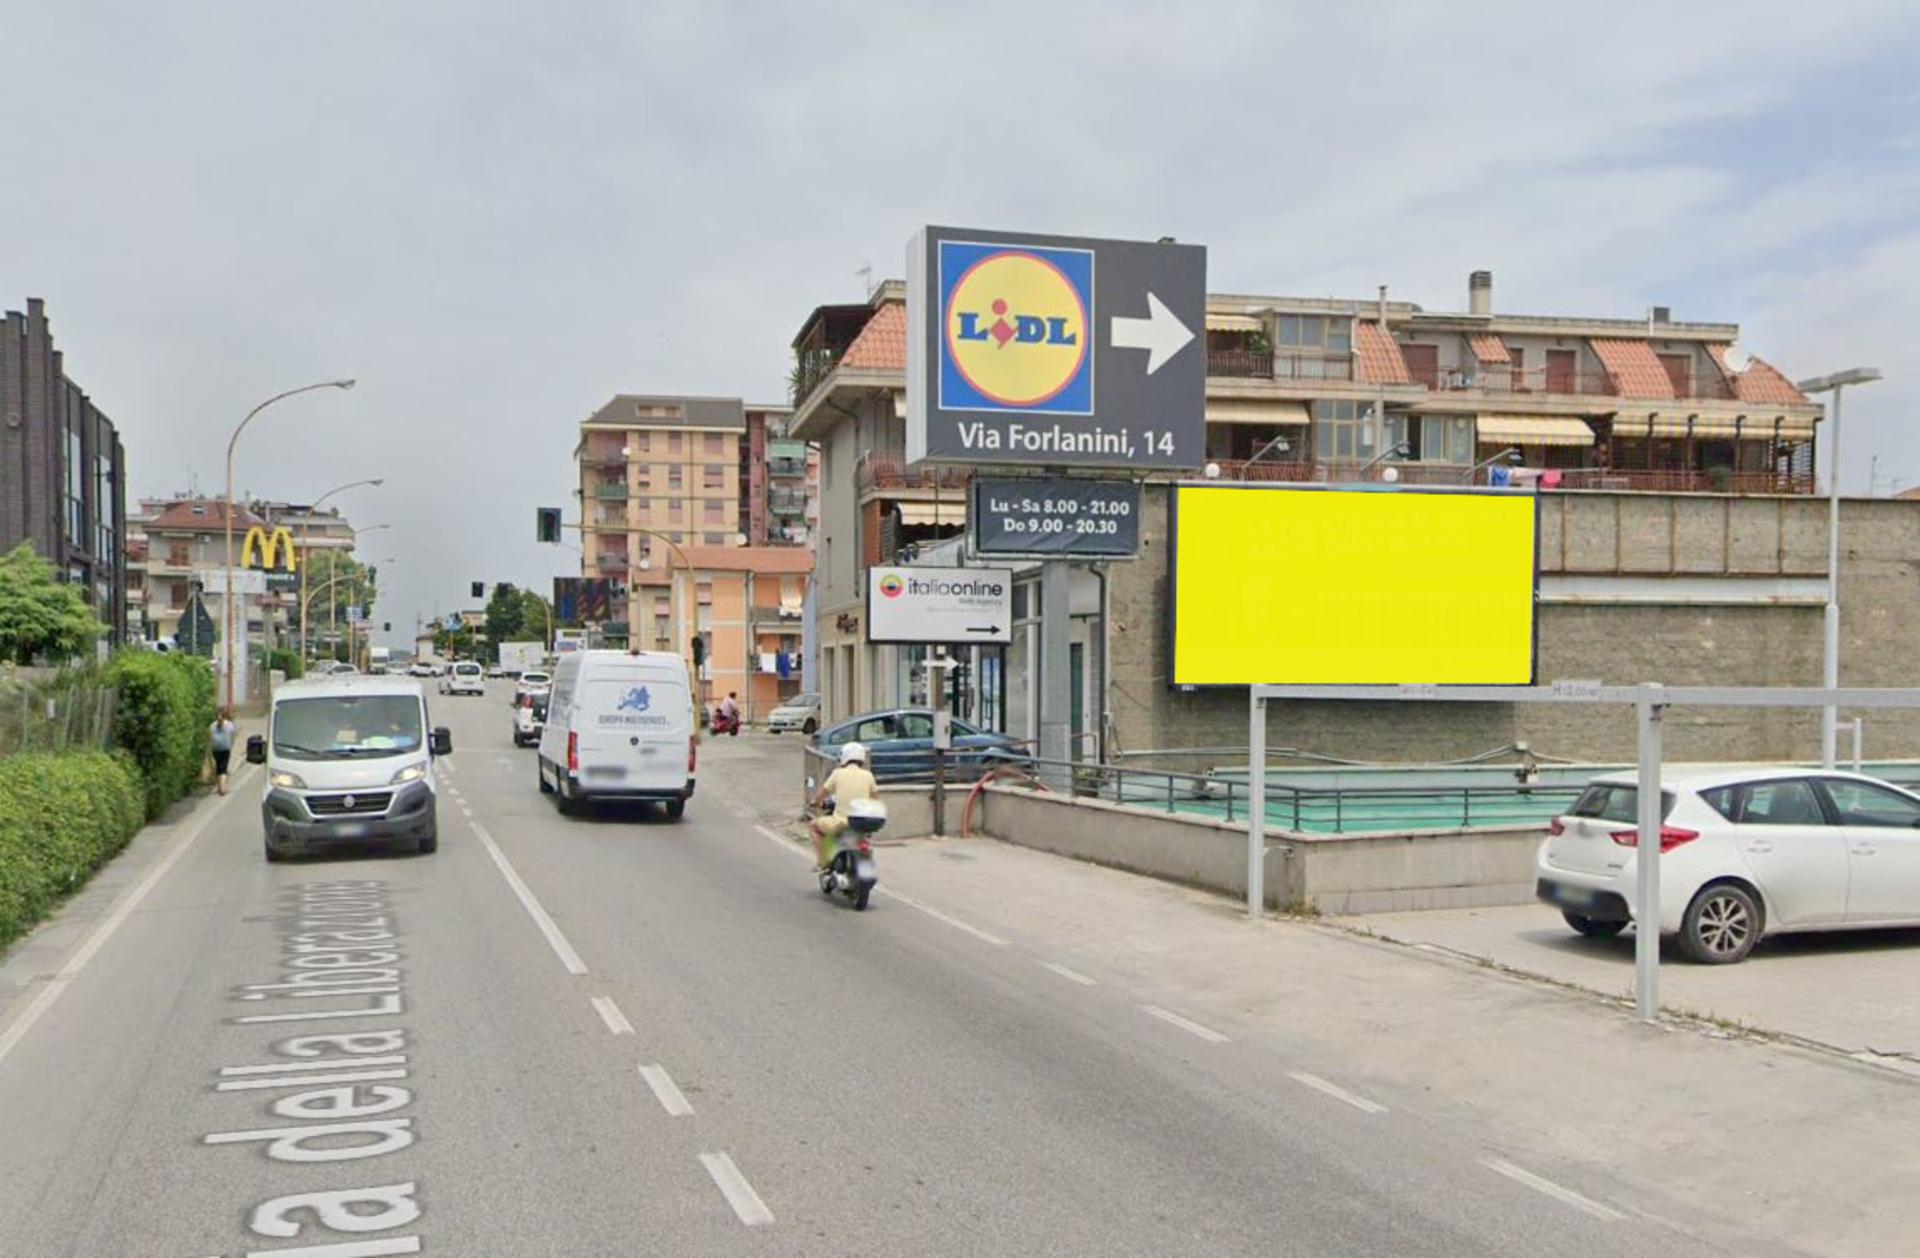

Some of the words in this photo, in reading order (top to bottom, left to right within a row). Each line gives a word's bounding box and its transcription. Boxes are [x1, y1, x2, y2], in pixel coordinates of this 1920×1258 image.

[958, 422, 1001, 450] Via
[1009, 424, 1136, 458] Forlanini,
[1143, 431, 1175, 456] 14
[990, 498, 1009, 512] Lu
[1022, 499, 1040, 513] Sa
[1043, 500, 1078, 514] 8.00
[1090, 501, 1131, 515] 21.00
[1003, 519, 1025, 532] Do
[1029, 519, 1064, 532] 9.00
[1076, 520, 1117, 534] 20.30
[908, 577, 1003, 597] italiaonline
